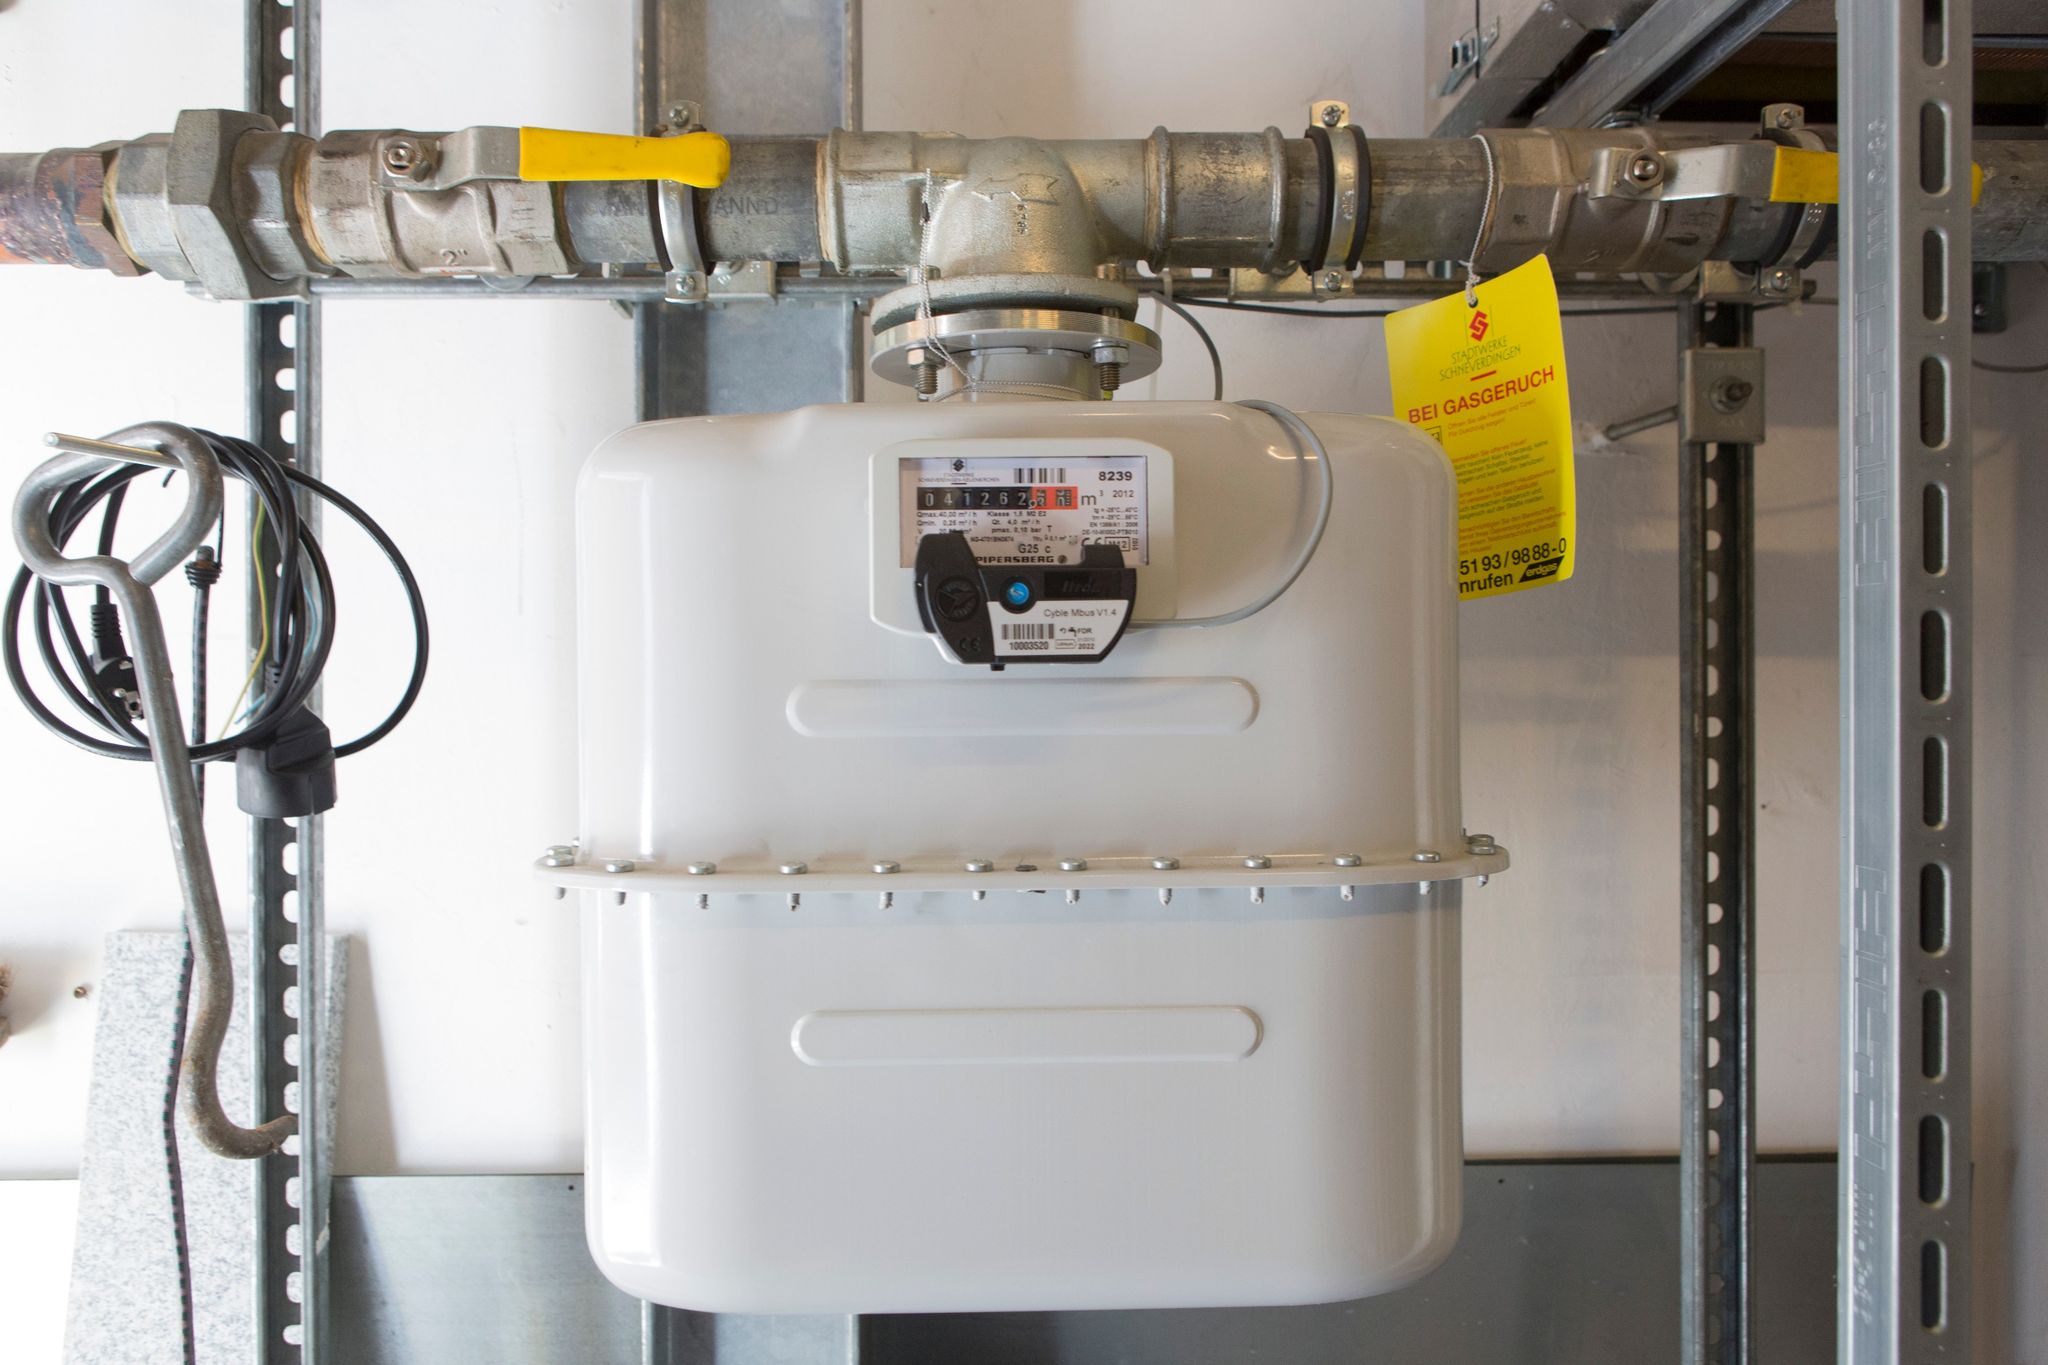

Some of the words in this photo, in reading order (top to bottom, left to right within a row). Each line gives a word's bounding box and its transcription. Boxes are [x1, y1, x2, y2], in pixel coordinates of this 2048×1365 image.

[1451, 336, 1508, 364] STADTWERKE
[1439, 344, 1521, 381] SCHNEVERDINGEN
[1408, 403, 1438, 424] BEI
[1443, 365, 1554, 416] GASGERUCH
[1098, 471, 1133, 481] 8239
[1112, 489, 1134, 498] 2012
[1018, 543, 1039, 553] G25
[1459, 573, 1513, 594] nrufen
[1043, 608, 1068, 618] Cyble
[1071, 608, 1095, 617] Mbus
[1096, 608, 1117, 617] V1.4
[1009, 641, 1049, 650] 10003520
